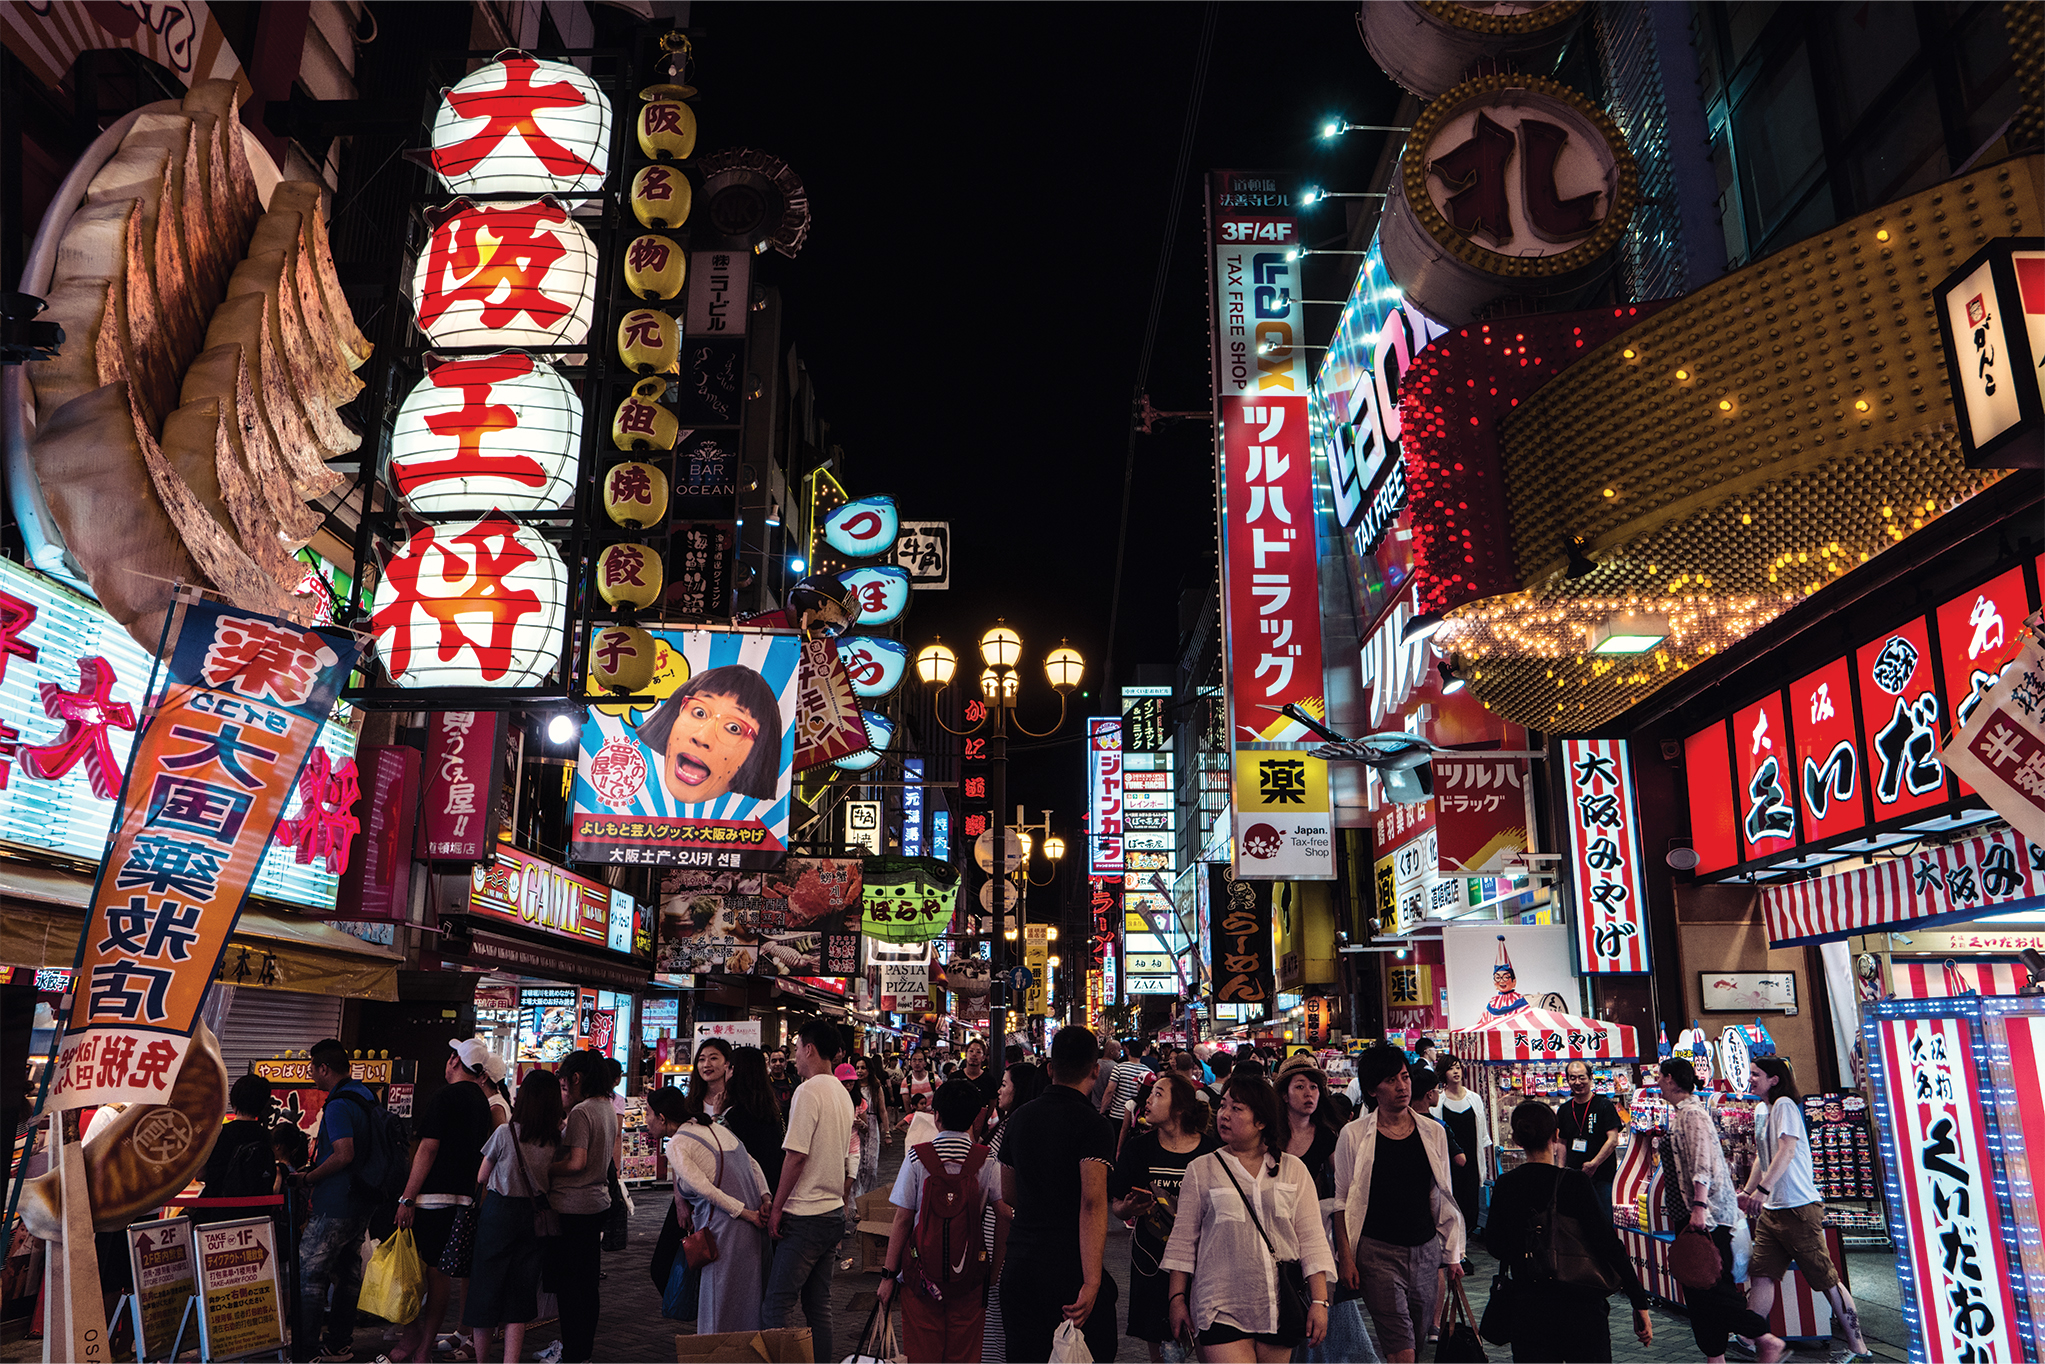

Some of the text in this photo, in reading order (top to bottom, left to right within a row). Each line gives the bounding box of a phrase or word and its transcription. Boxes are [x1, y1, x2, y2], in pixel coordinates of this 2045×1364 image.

[1219, 193, 1290, 207] 法善寺ビル
[1221, 222, 1293, 241] 3F/4F
[1227, 254, 1247, 390] TAX FREE SHOP
[690, 464, 725, 476] BAR
[676, 484, 735, 496] OCEAN
[899, 537, 943, 575] 牛角
[1243, 406, 1302, 698] ツルハドラッグ
[1258, 758, 1307, 805] 薬
[1436, 763, 1521, 789] ツルハ
[1100, 753, 1121, 862] ジャンカラ
[1129, 800, 1165, 809] レインボー
[1439, 793, 1506, 813] ドラッグ
[1294, 825, 1329, 837] Japan.
[424, 841, 476, 856] 道頓堀店
[1290, 836, 1330, 848] Tax-free
[717, 850, 742, 868] 선물
[1304, 847, 1330, 860] Shop
[1399, 847, 1420, 878] くすり
[1573, 750, 1637, 960] 大阪みやげ
[520, 862, 583, 935] GAME
[862, 898, 942, 923] ぼらや
[1968, 934, 2044, 949] くいだおれ
[884, 964, 927, 976] PASTA
[885, 981, 927, 993] PIZZA
[1031, 962, 1043, 999] 一番搾り
[1133, 980, 1165, 990] ZAZA
[1391, 969, 1419, 1003] 薬
[914, 998, 928, 1008] 2F
[1514, 1030, 1608, 1052] 大阪みやげ
[160, 1227, 177, 1246] 2F
[204, 1232, 227, 1242] TAKE
[207, 1240, 225, 1251] OUT
[236, 1229, 254, 1246] 1F
